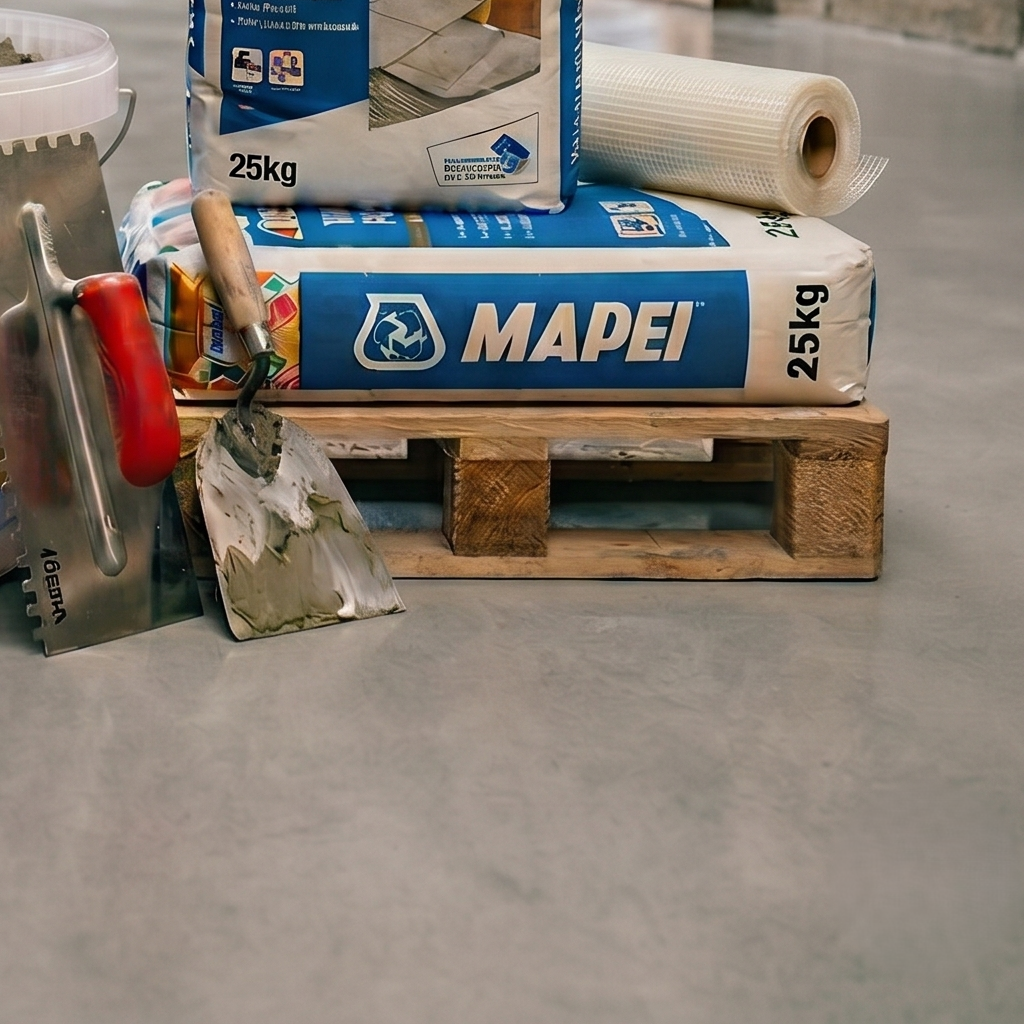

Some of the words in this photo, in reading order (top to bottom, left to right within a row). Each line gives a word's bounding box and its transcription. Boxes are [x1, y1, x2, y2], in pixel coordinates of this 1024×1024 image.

[228, 152, 297, 187] 25kg
[461, 300, 694, 363] MAPEI
[787, 284, 829, 382] 25kg
